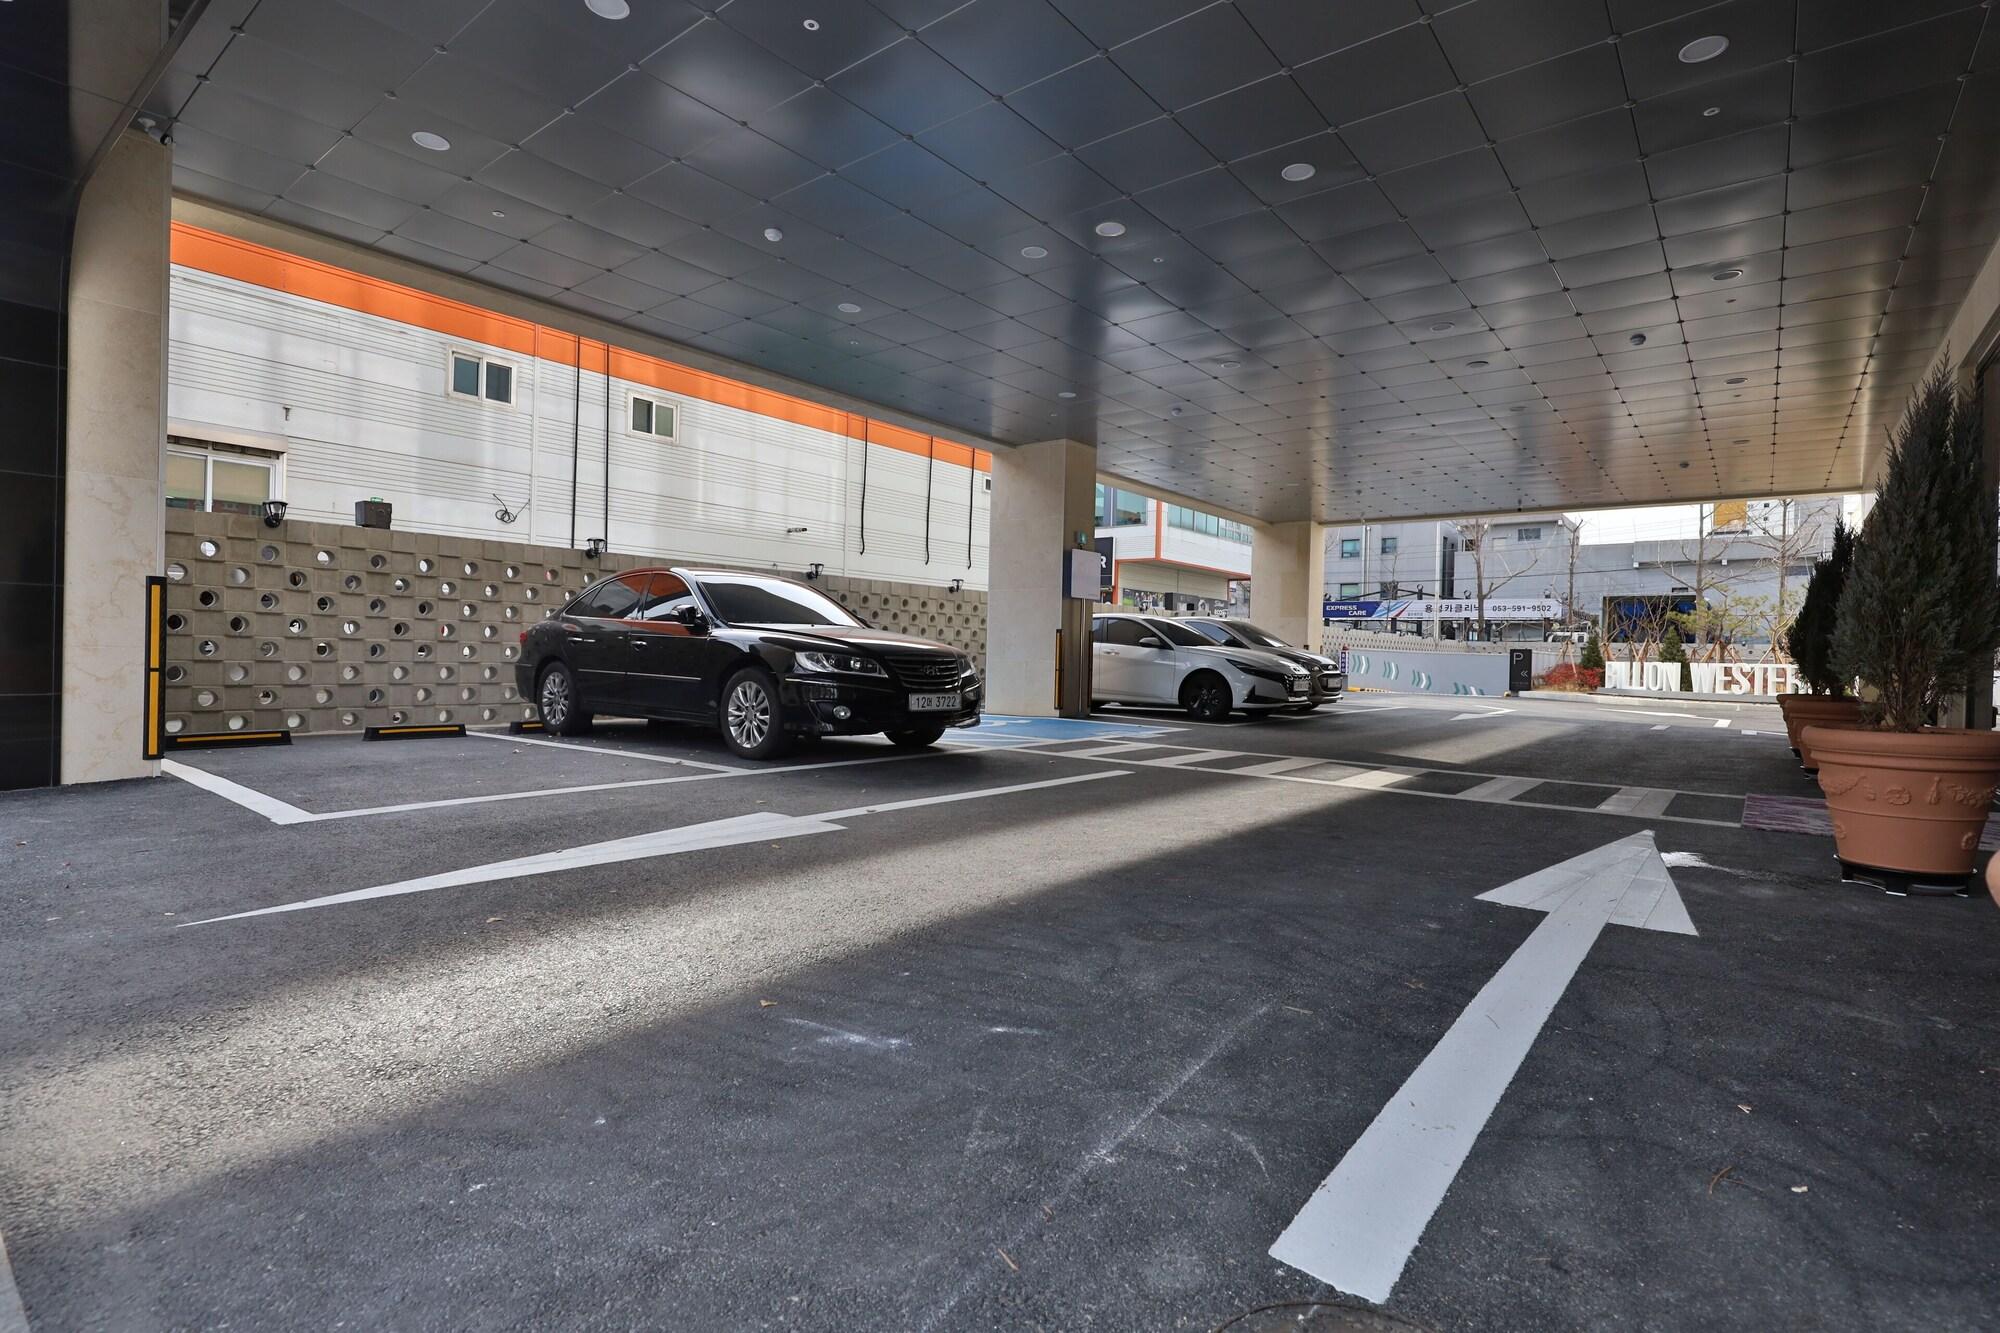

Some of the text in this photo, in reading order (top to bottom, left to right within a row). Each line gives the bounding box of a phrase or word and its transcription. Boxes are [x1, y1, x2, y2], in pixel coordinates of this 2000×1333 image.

[1492, 604, 1552, 613] 053-591-9502
[1513, 652, 1524, 665] P
[1604, 661, 1682, 692] BILLION
[935, 695, 957, 708] 3722
